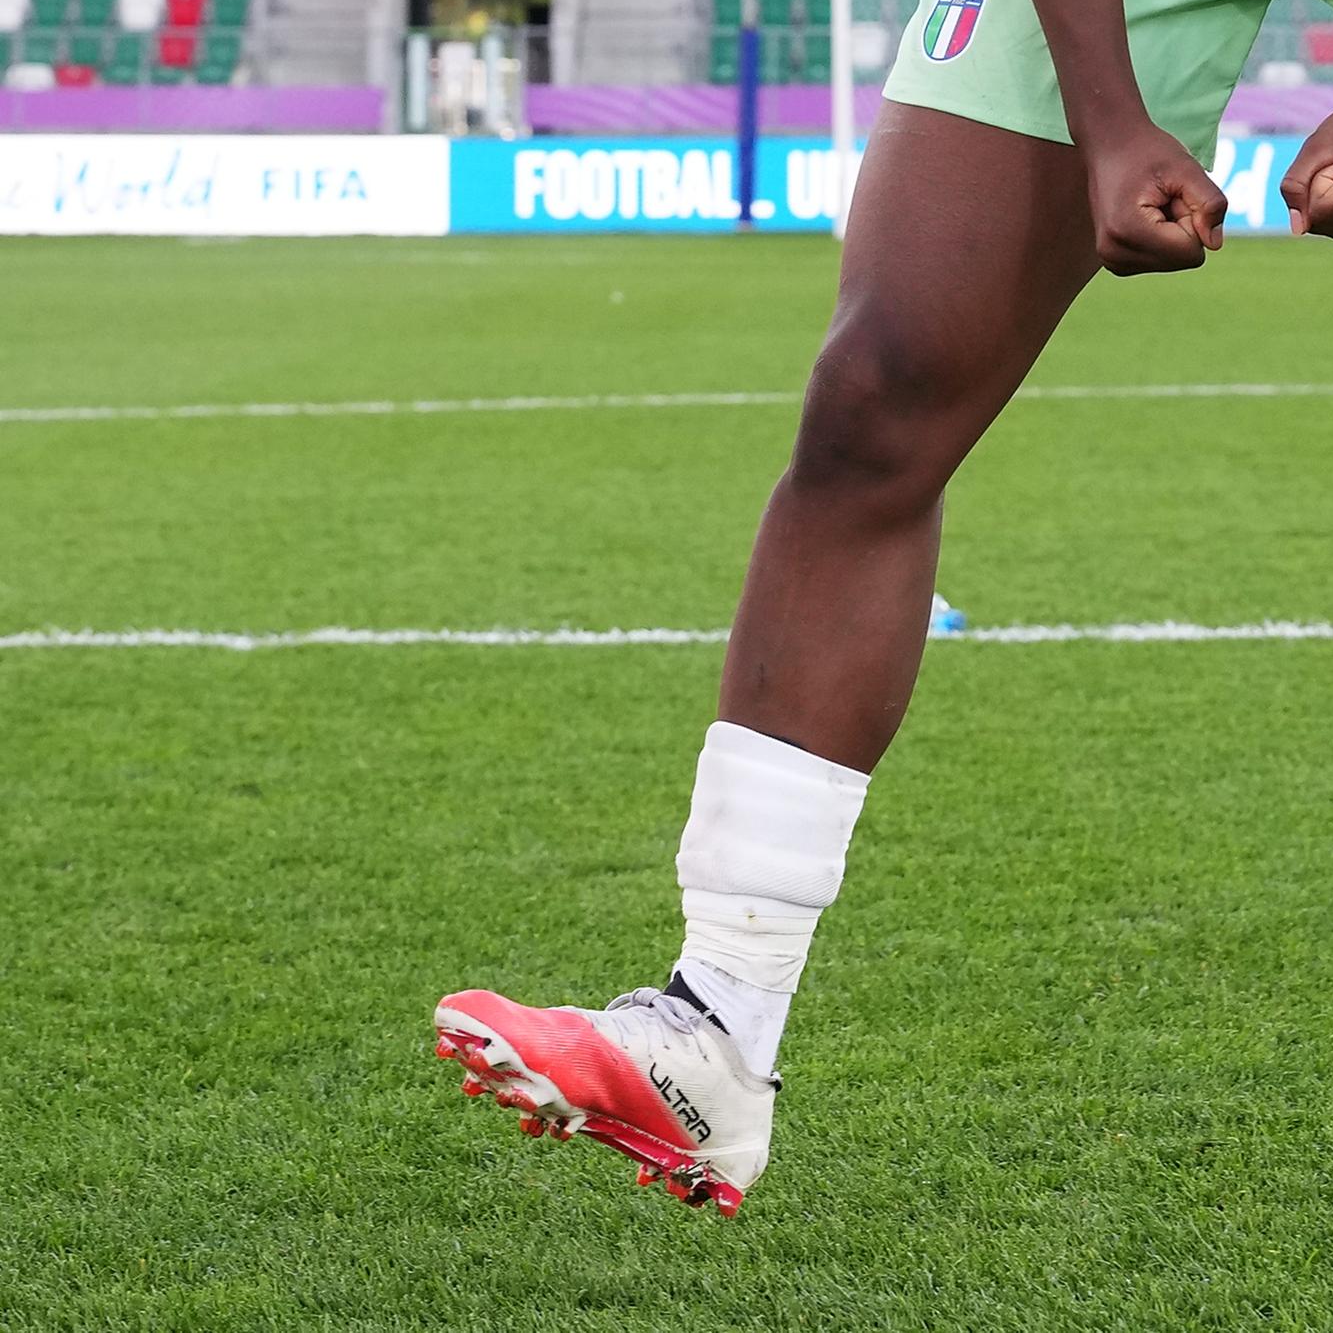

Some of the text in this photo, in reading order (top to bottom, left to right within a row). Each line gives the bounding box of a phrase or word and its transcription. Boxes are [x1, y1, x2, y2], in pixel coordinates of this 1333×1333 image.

[53, 146, 221, 217] World
[262, 168, 368, 201] FIFA
[649, 1061, 712, 1144] ULTRA
